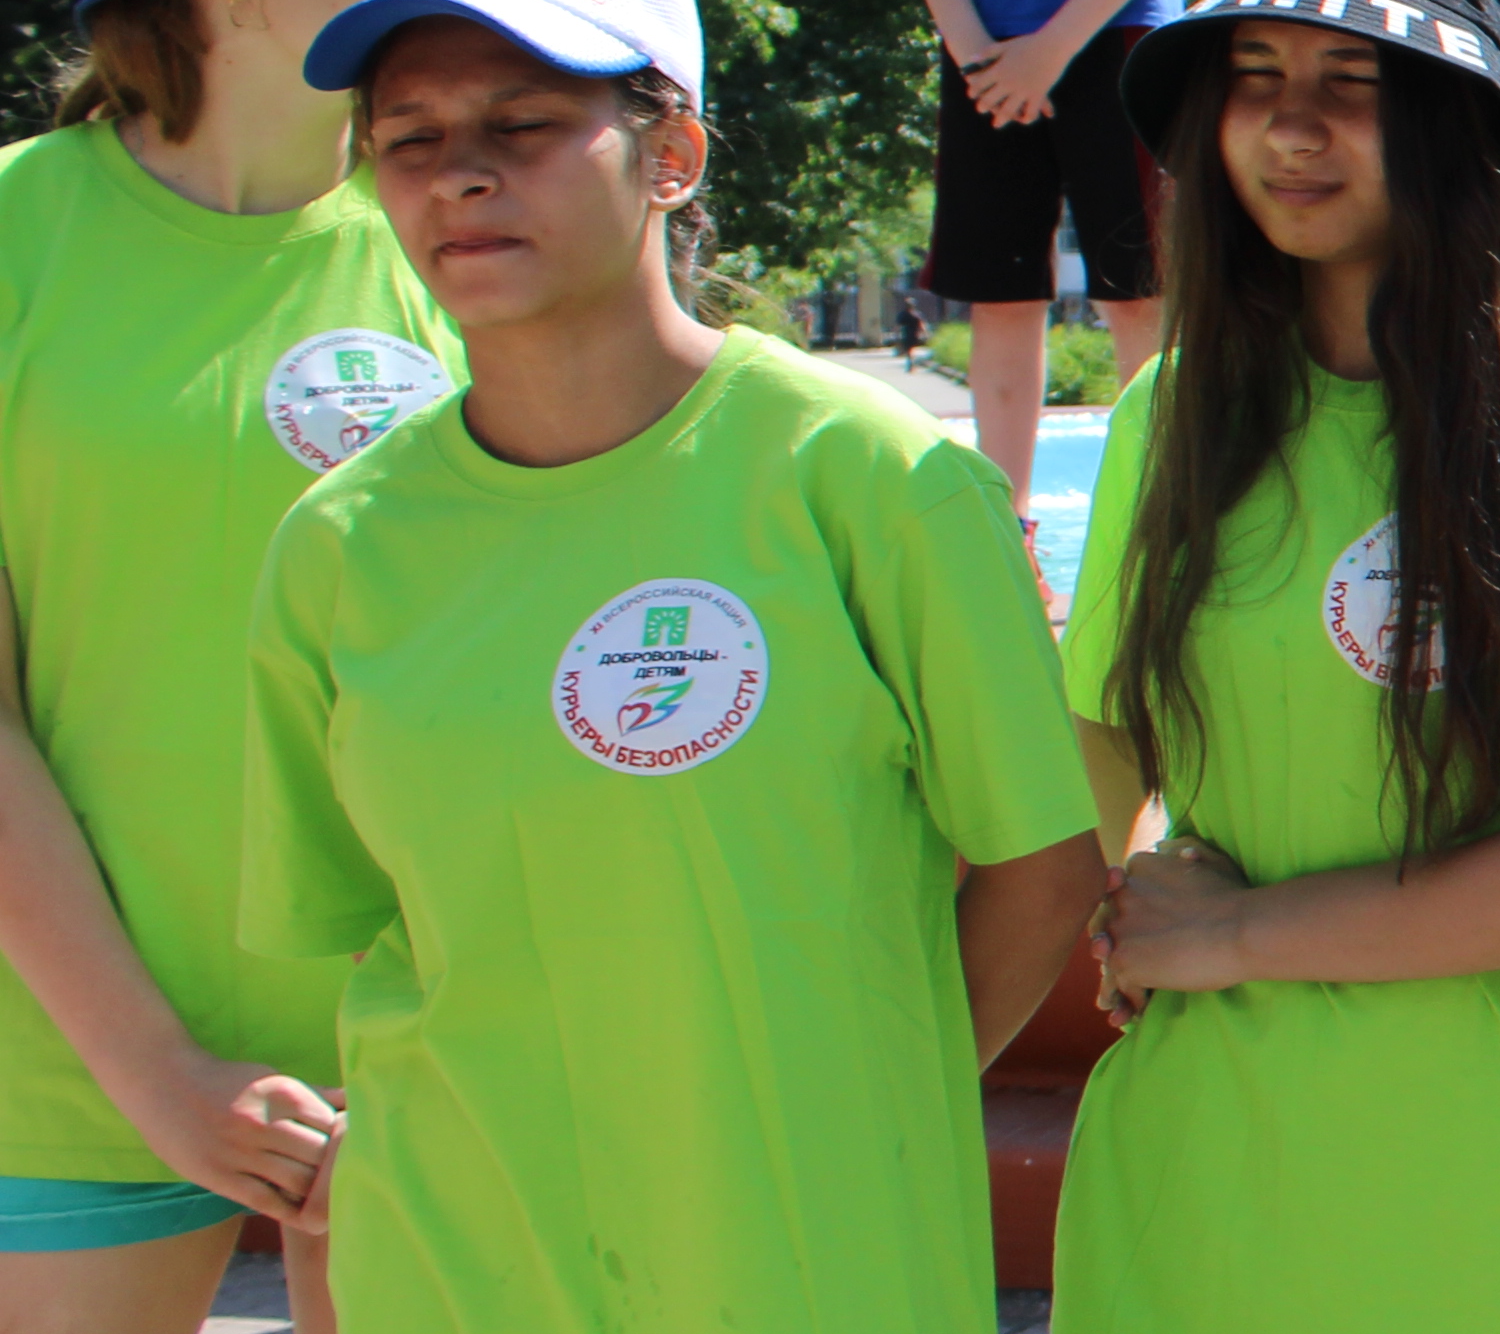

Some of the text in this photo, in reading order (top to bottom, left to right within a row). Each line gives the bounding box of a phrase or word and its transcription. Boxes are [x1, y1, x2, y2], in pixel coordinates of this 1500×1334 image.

[305, 382, 415, 398] ДОБРОВОЛЬЦЫ
[275, 403, 341, 469] КУРЬЕРЫ
[602, 586, 712, 624] ВСЕРОССИЙСКАЯ
[711, 597, 747, 629] АКЦИЯ
[1329, 580, 1375, 673] КУРЬЕРЫ
[598, 649, 719, 666] ДОБРОВОЛЬЦЫ
[633, 666, 686, 679] ДЕТЯМ
[560, 669, 760, 768] КУРЬЕРЫ БЕЗОПАСНОСТИ
